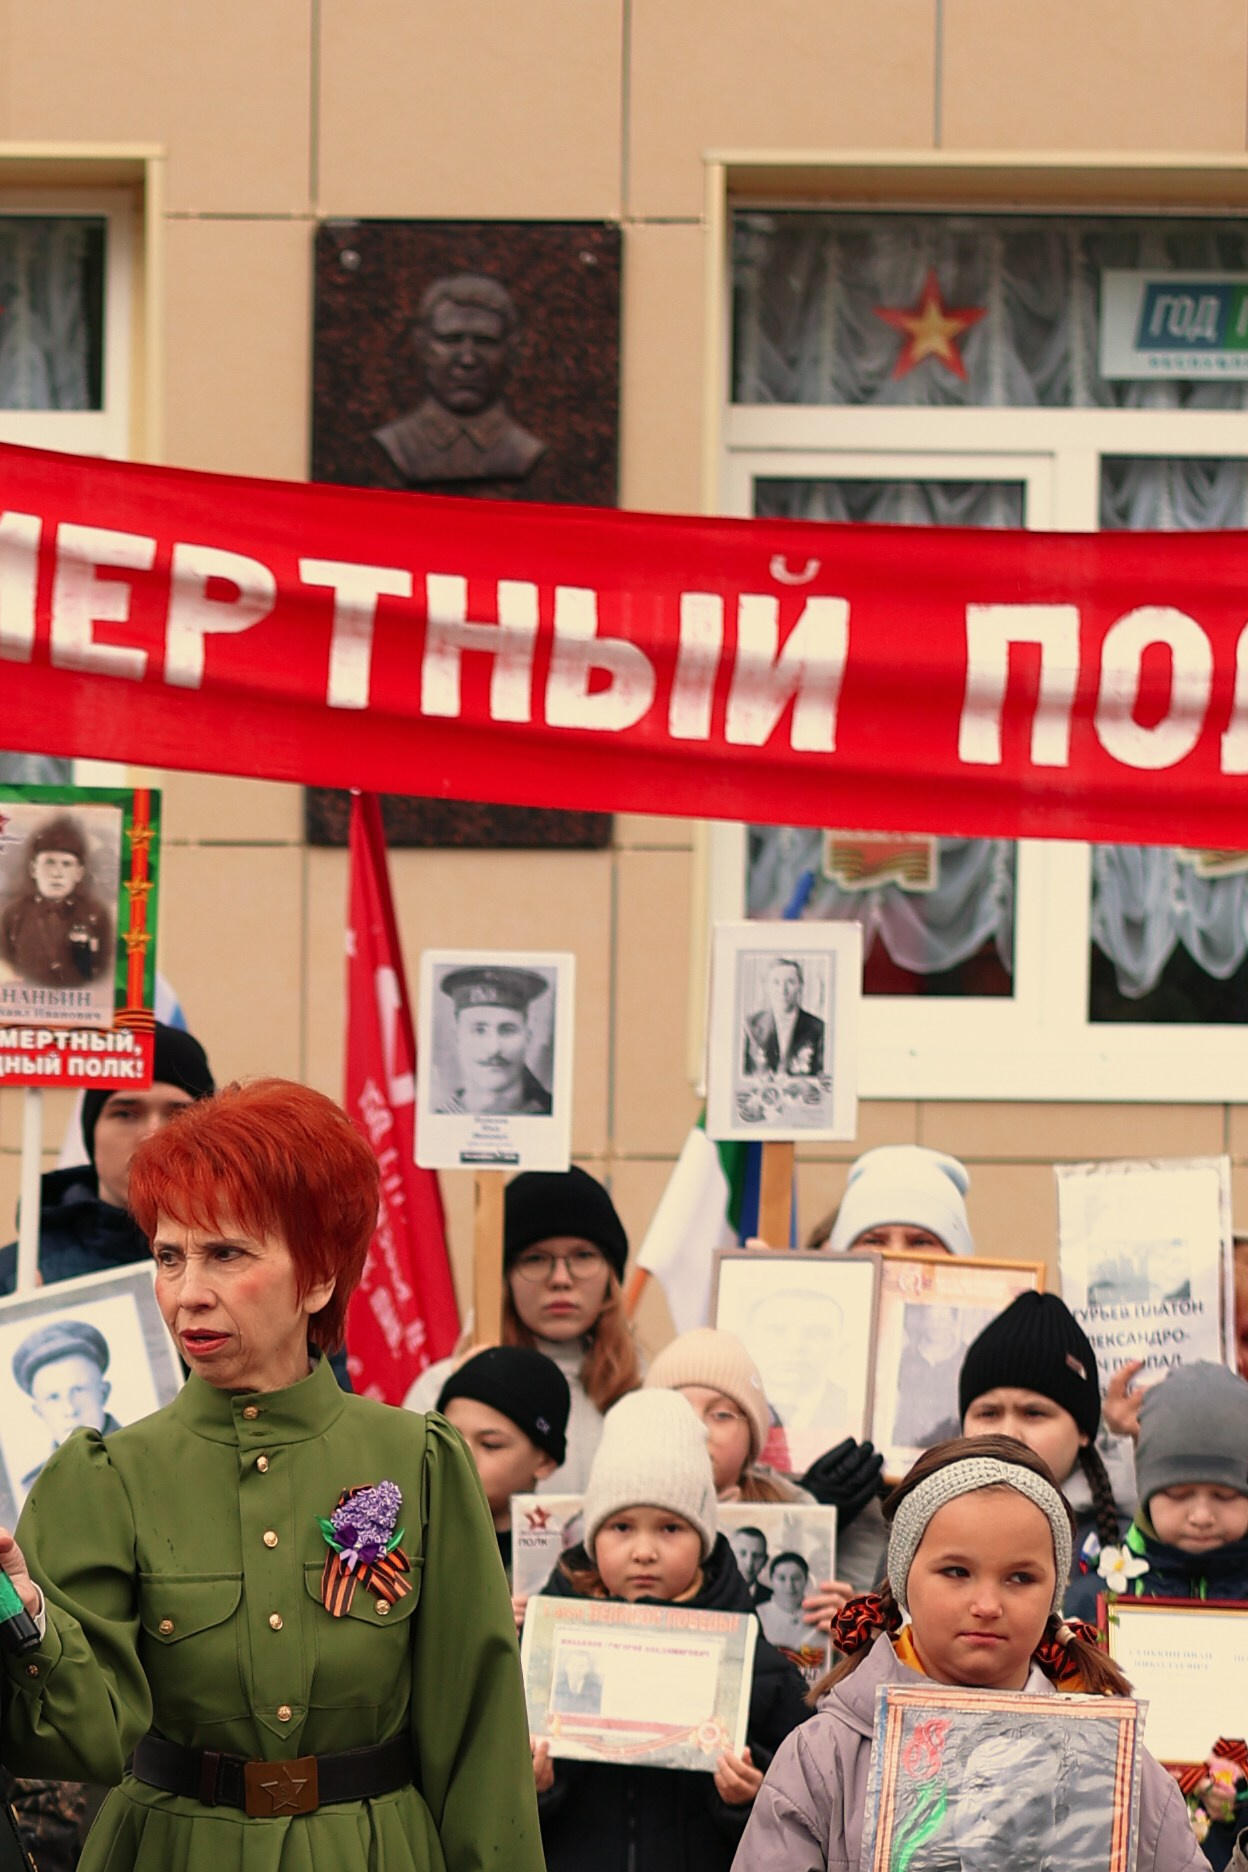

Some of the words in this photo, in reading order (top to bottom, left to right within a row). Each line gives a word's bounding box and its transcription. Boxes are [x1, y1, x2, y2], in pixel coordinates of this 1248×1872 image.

[1150, 294, 1221, 343] ГОД
[33, 1007, 102, 1021] Иванович
[68, 1056, 145, 1078] ПОЛК!
[1135, 1300, 1203, 1318] ПЛАТОН
[1088, 1329, 1191, 1348] ЛЕКСАНДРО-
[518, 1537, 549, 1547] ПОЛК
